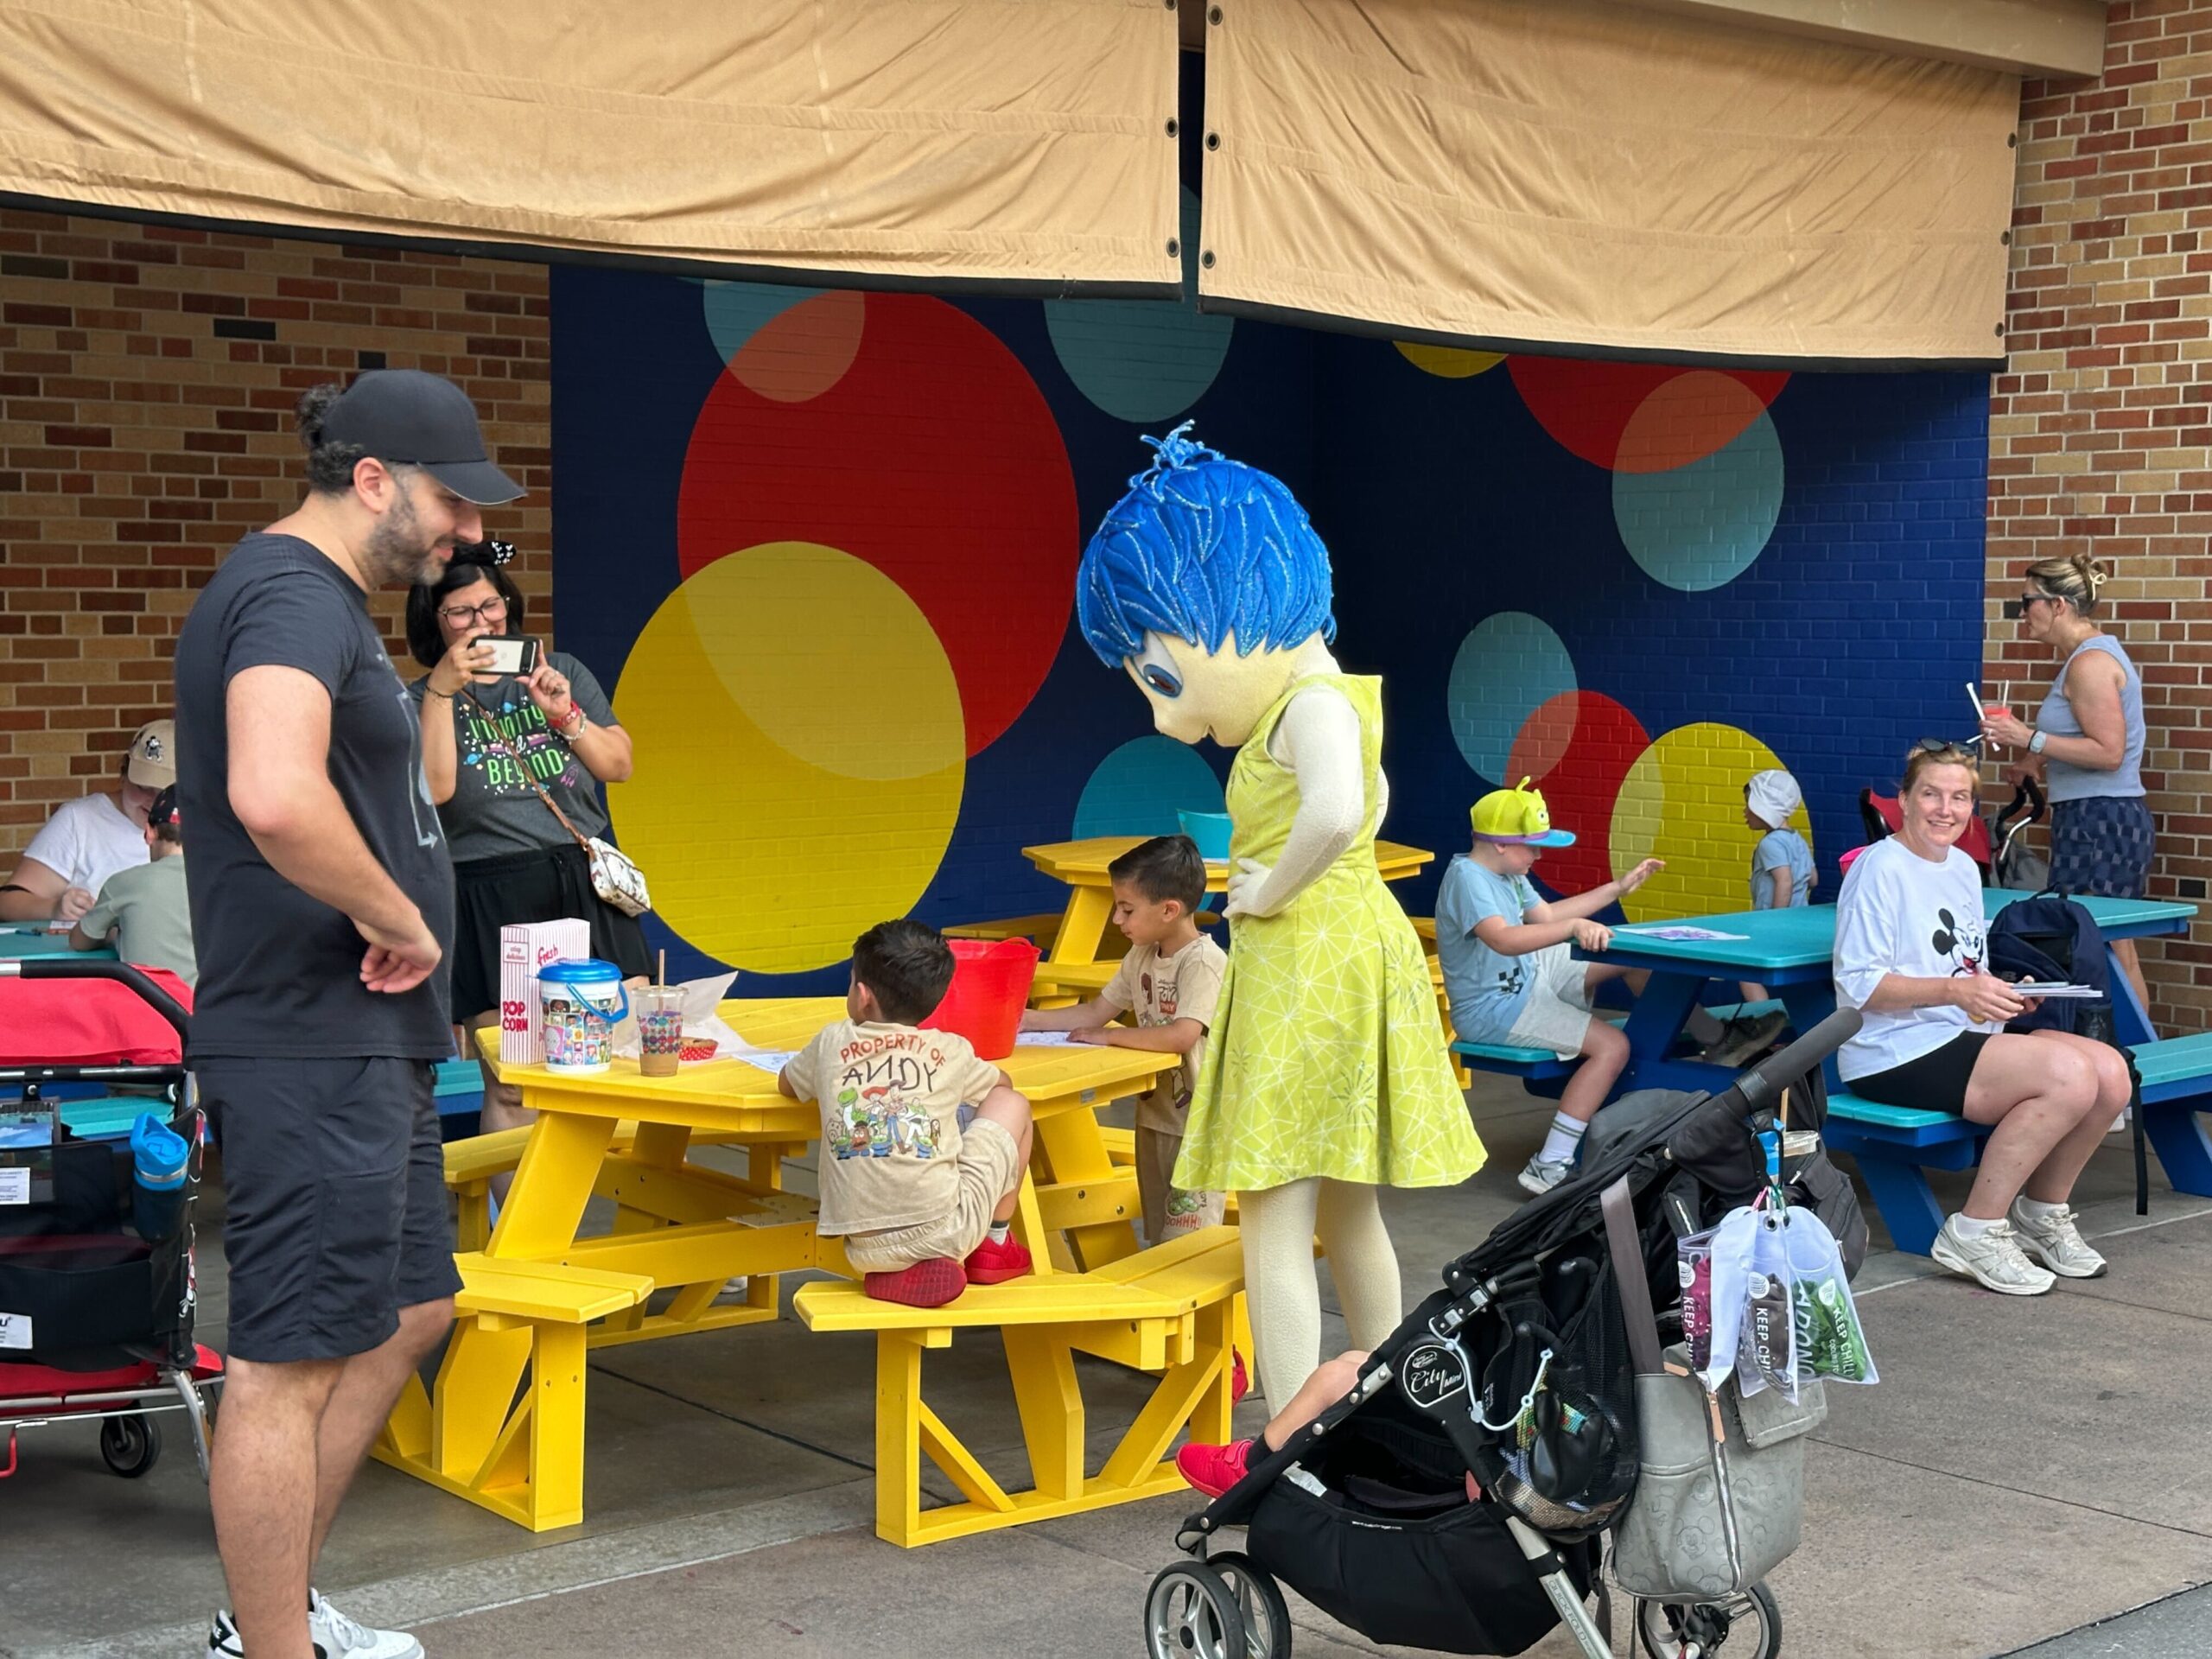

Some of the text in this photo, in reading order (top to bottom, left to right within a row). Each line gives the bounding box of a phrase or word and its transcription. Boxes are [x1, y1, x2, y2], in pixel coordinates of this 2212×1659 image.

[502, 1001, 525, 1016] POP
[502, 1018, 528, 1032] CORN
[840, 1033, 946, 1067] PROPERTY OF
[842, 1055, 938, 1092] ANDY
[1683, 1296, 1695, 1329] KEEP
[1756, 1307, 1770, 1341] KEEP
[1833, 1306, 1847, 1339] KEEP
[1410, 1369, 1446, 1395] City
